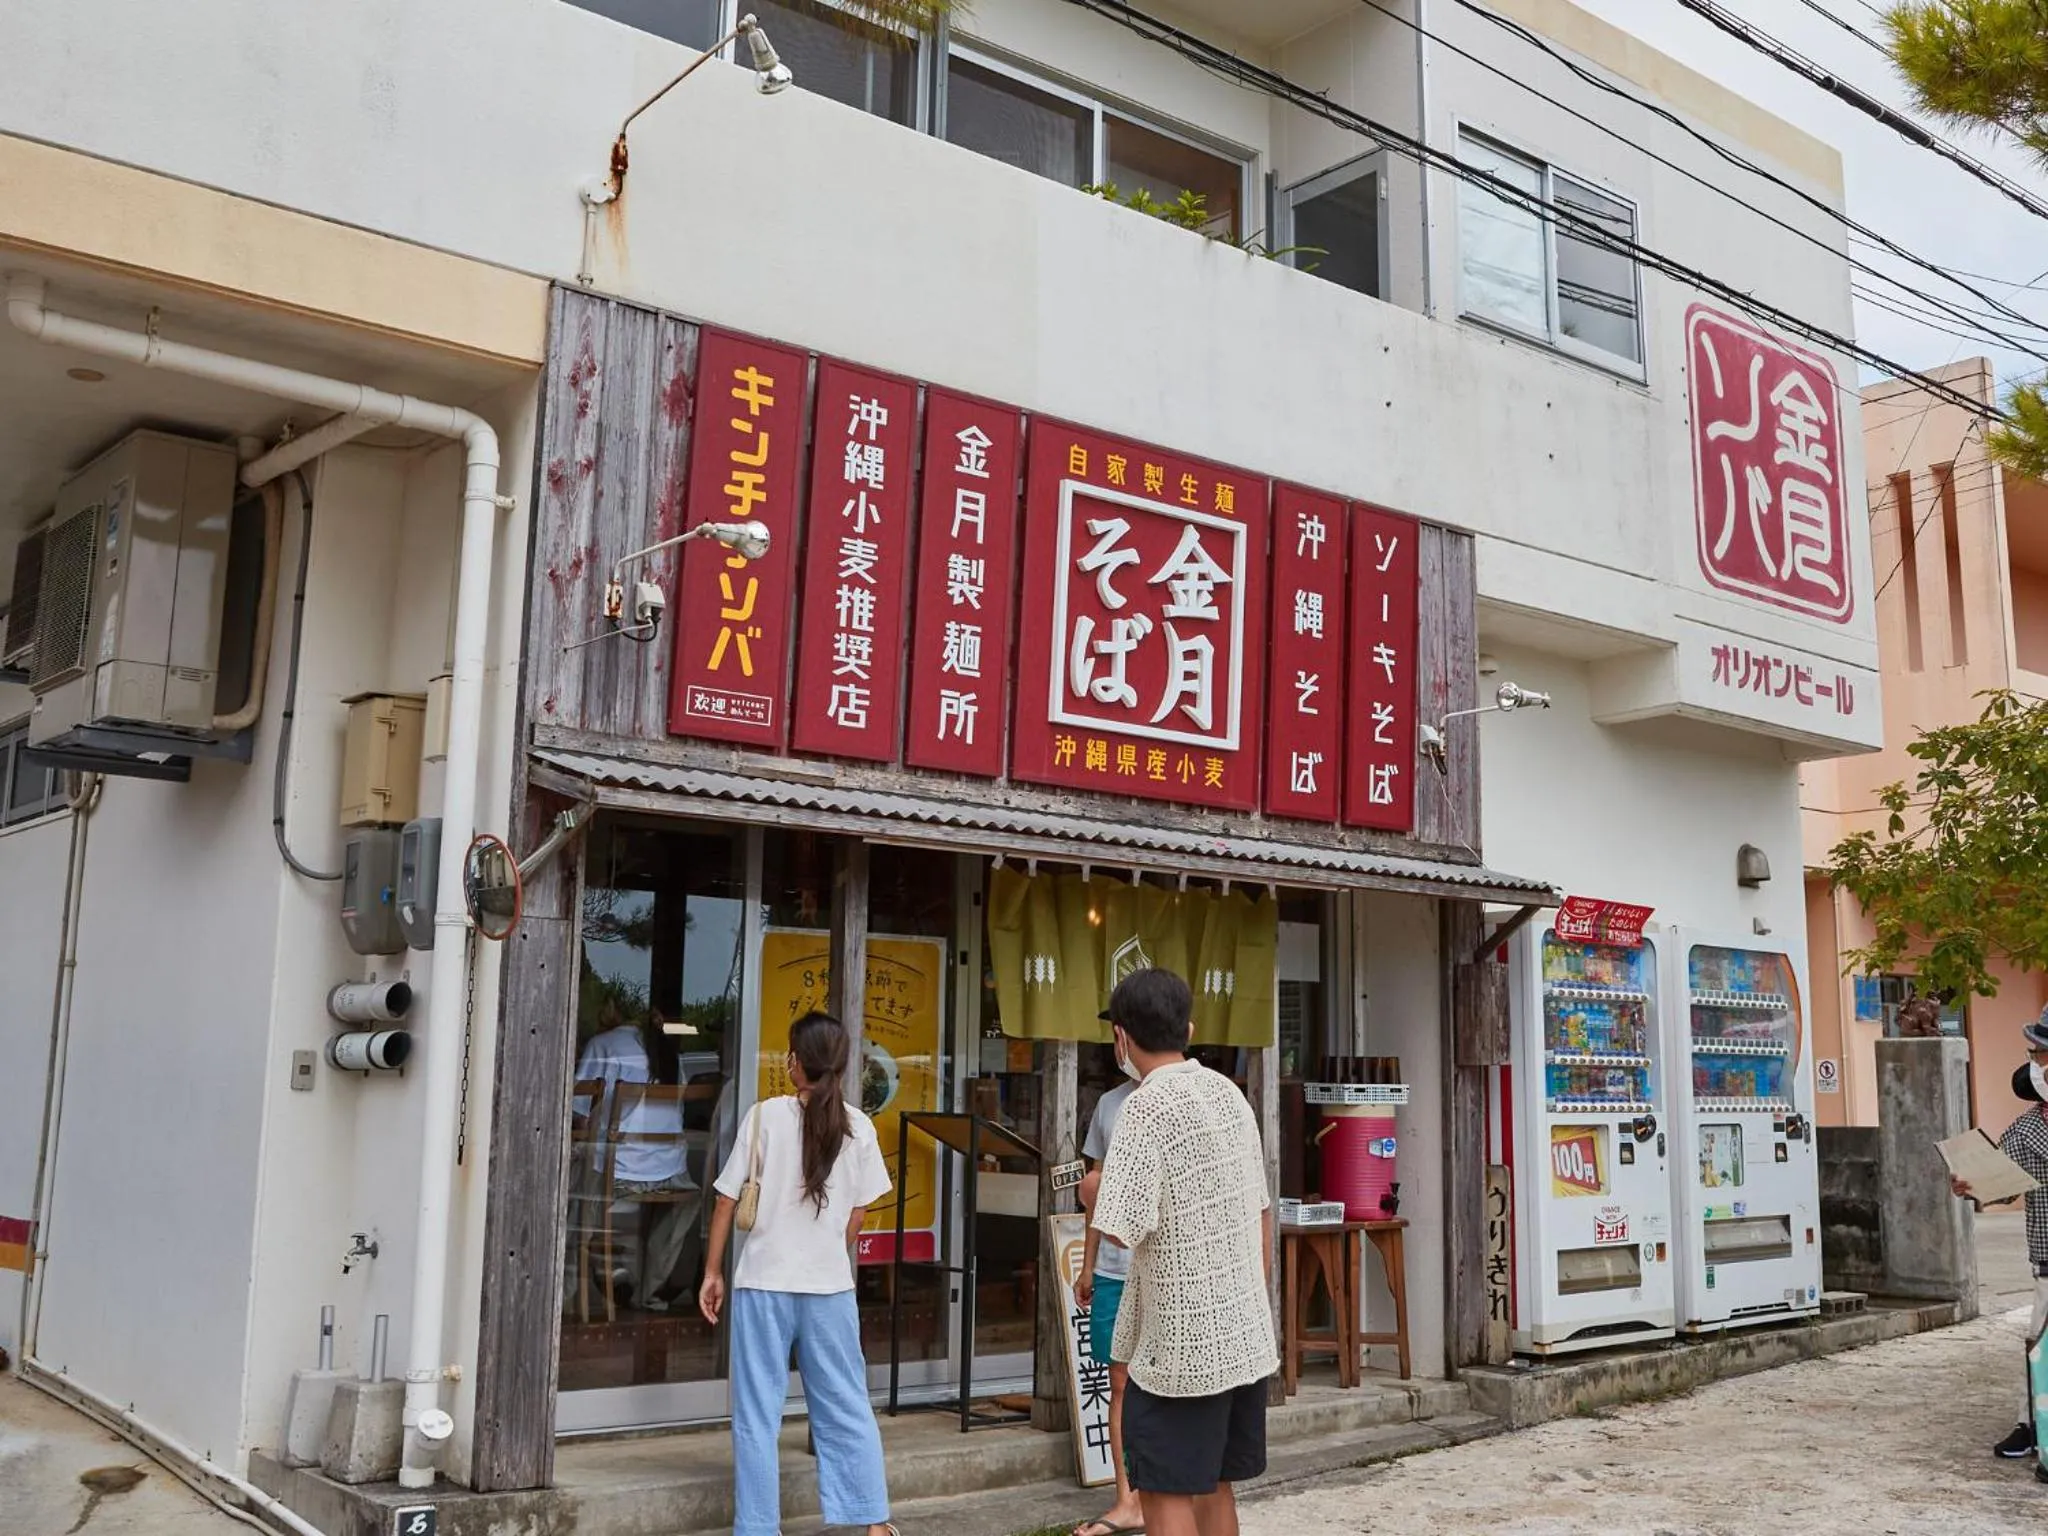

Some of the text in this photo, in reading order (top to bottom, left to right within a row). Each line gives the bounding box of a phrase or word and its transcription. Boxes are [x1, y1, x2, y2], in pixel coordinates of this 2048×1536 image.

[1069, 444, 1235, 514] 自家製生麺
[1770, 370, 1840, 597] 金月
[827, 394, 888, 729] 沖縄小麦推奨店
[937, 425, 993, 745] 金月製麺所
[1077, 518, 1152, 709] そば
[1147, 524, 1233, 730] 金月
[1291, 512, 1325, 794] 沖縄そば
[1369, 534, 1399, 805] ソーキそば
[1711, 644, 1855, 716] オリオンビール
[1054, 734, 1225, 788] 沖縄県産小麦
[1056, 1170, 1082, 1186] OPEN
[1553, 1142, 1595, 1184] 100円
[1596, 1221, 1627, 1241] チェリオ
[1487, 1186, 1508, 1321] うりきれ
